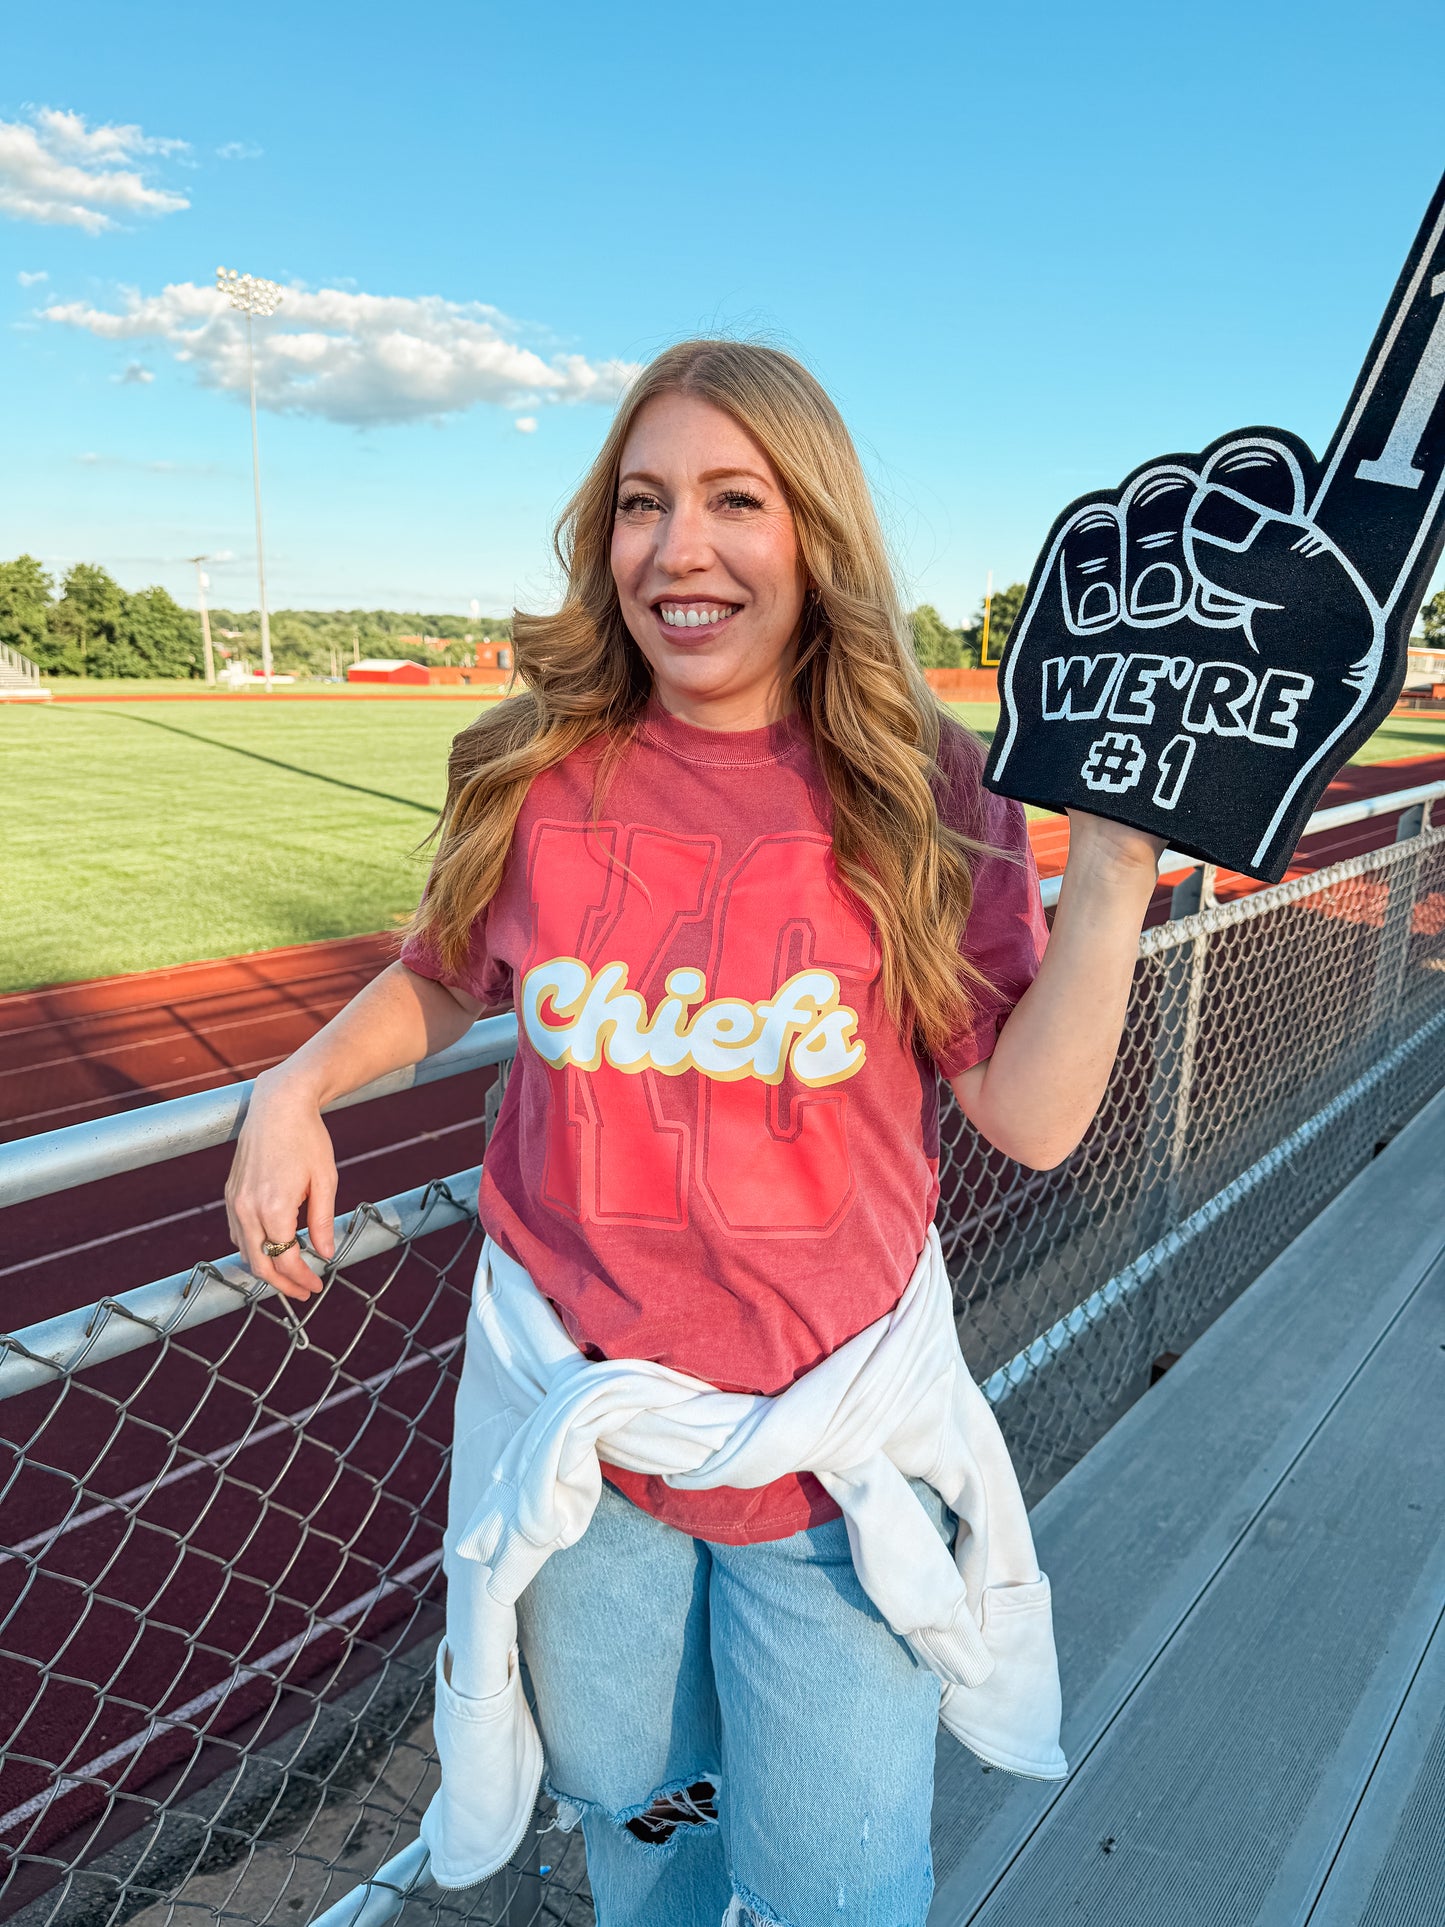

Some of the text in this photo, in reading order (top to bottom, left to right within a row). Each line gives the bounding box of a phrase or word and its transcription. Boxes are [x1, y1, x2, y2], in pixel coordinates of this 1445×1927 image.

[1042, 653, 1314, 748] WE'RE
[1081, 732, 1196, 810] #1
[521, 818, 881, 1238] KC
[522, 957, 866, 1087] Chiefs
